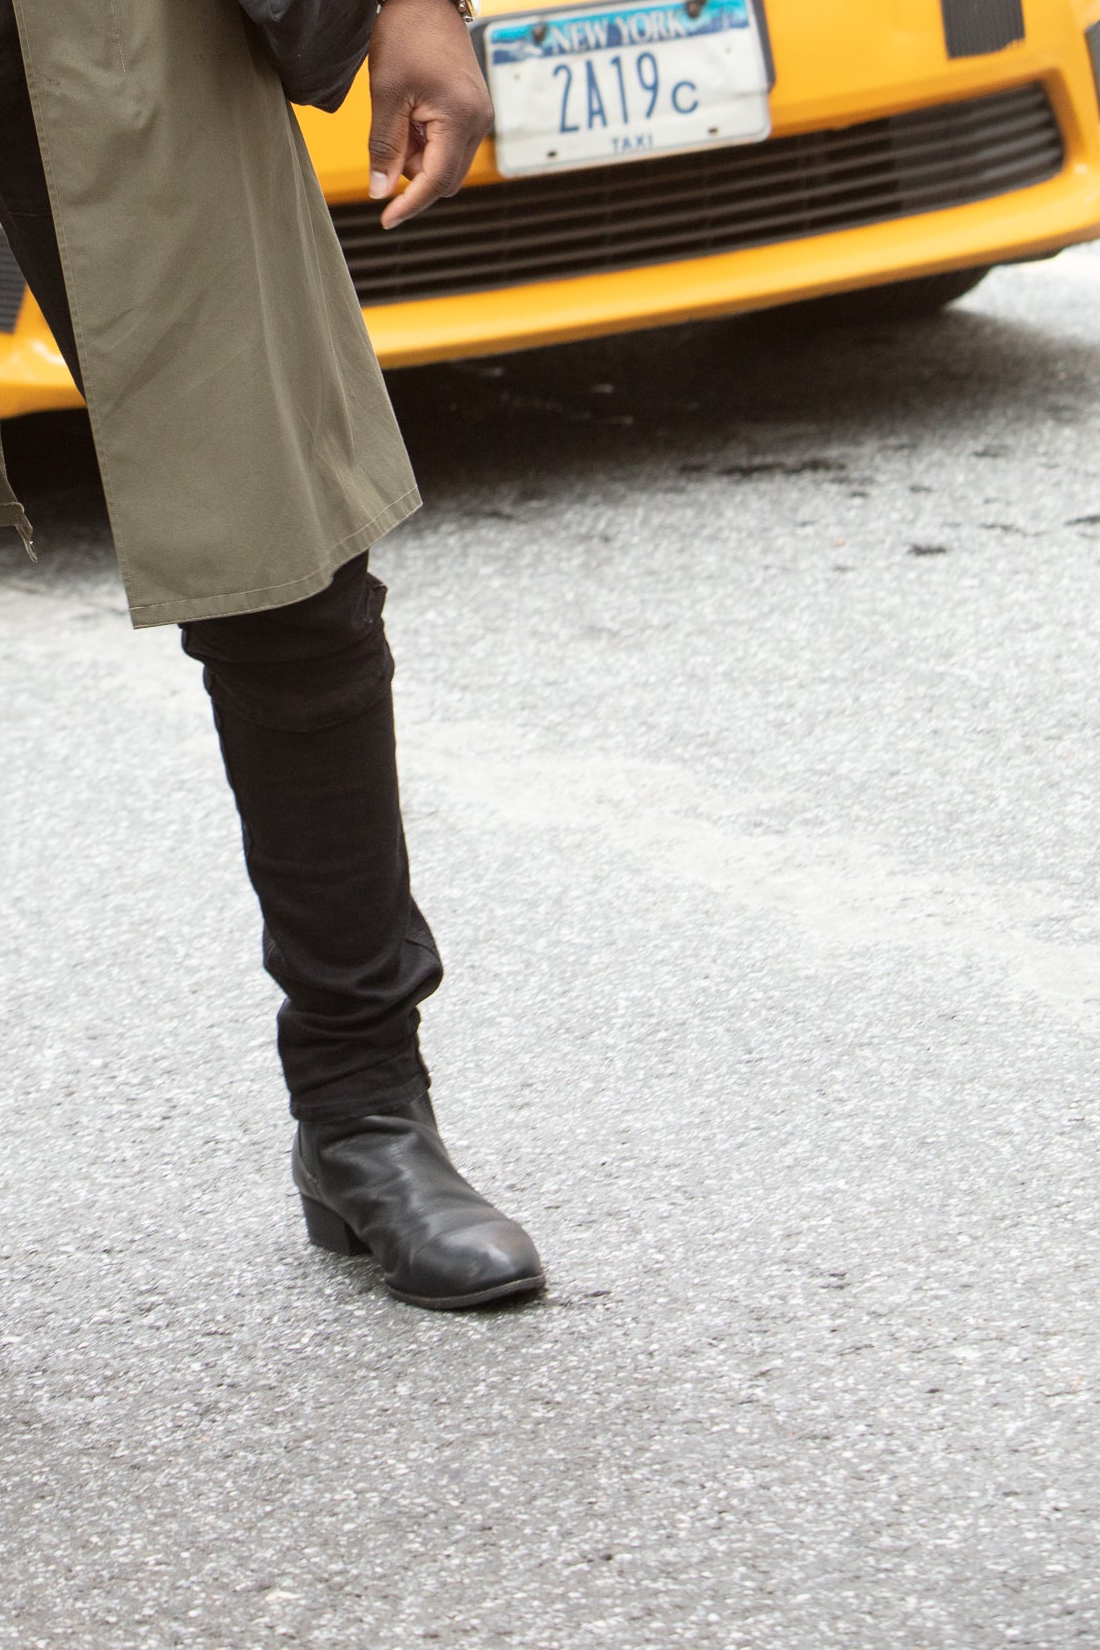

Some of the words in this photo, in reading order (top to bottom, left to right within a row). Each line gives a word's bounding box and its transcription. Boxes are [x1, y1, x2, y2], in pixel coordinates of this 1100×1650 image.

[549, 20, 614, 53] NEW
[616, 11, 687, 45] YORK
[612, 134, 655, 154] TAXI
